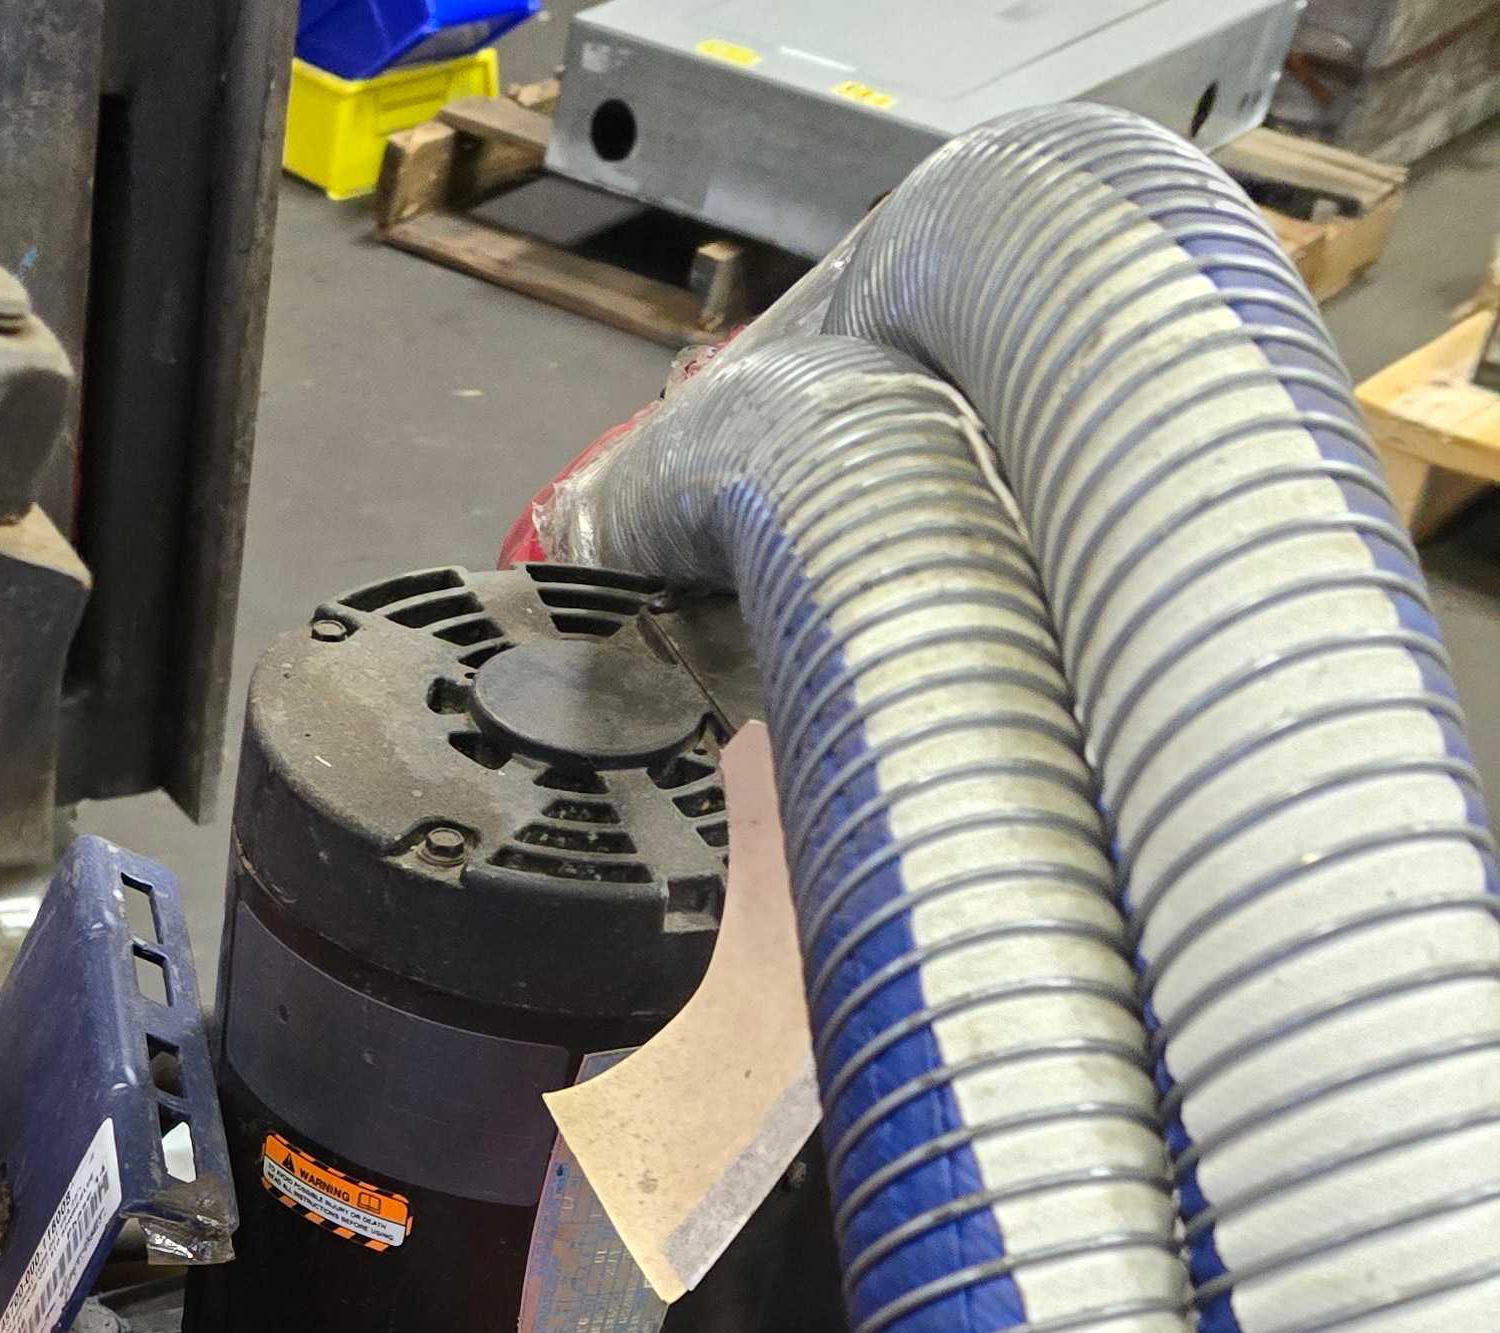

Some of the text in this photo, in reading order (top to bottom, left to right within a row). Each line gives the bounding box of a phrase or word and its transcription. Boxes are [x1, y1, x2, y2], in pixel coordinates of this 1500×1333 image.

[267, 1162, 387, 1230] TO AVOID POSSIBLE INJURY OR DEATH
[267, 1171, 282, 1186] READ
[282, 1183, 293, 1195] ALL
[293, 1190, 339, 1220] INSTRUCTIONS
[341, 1216, 368, 1232] BEFORE
[299, 1167, 351, 1203] WARNING
